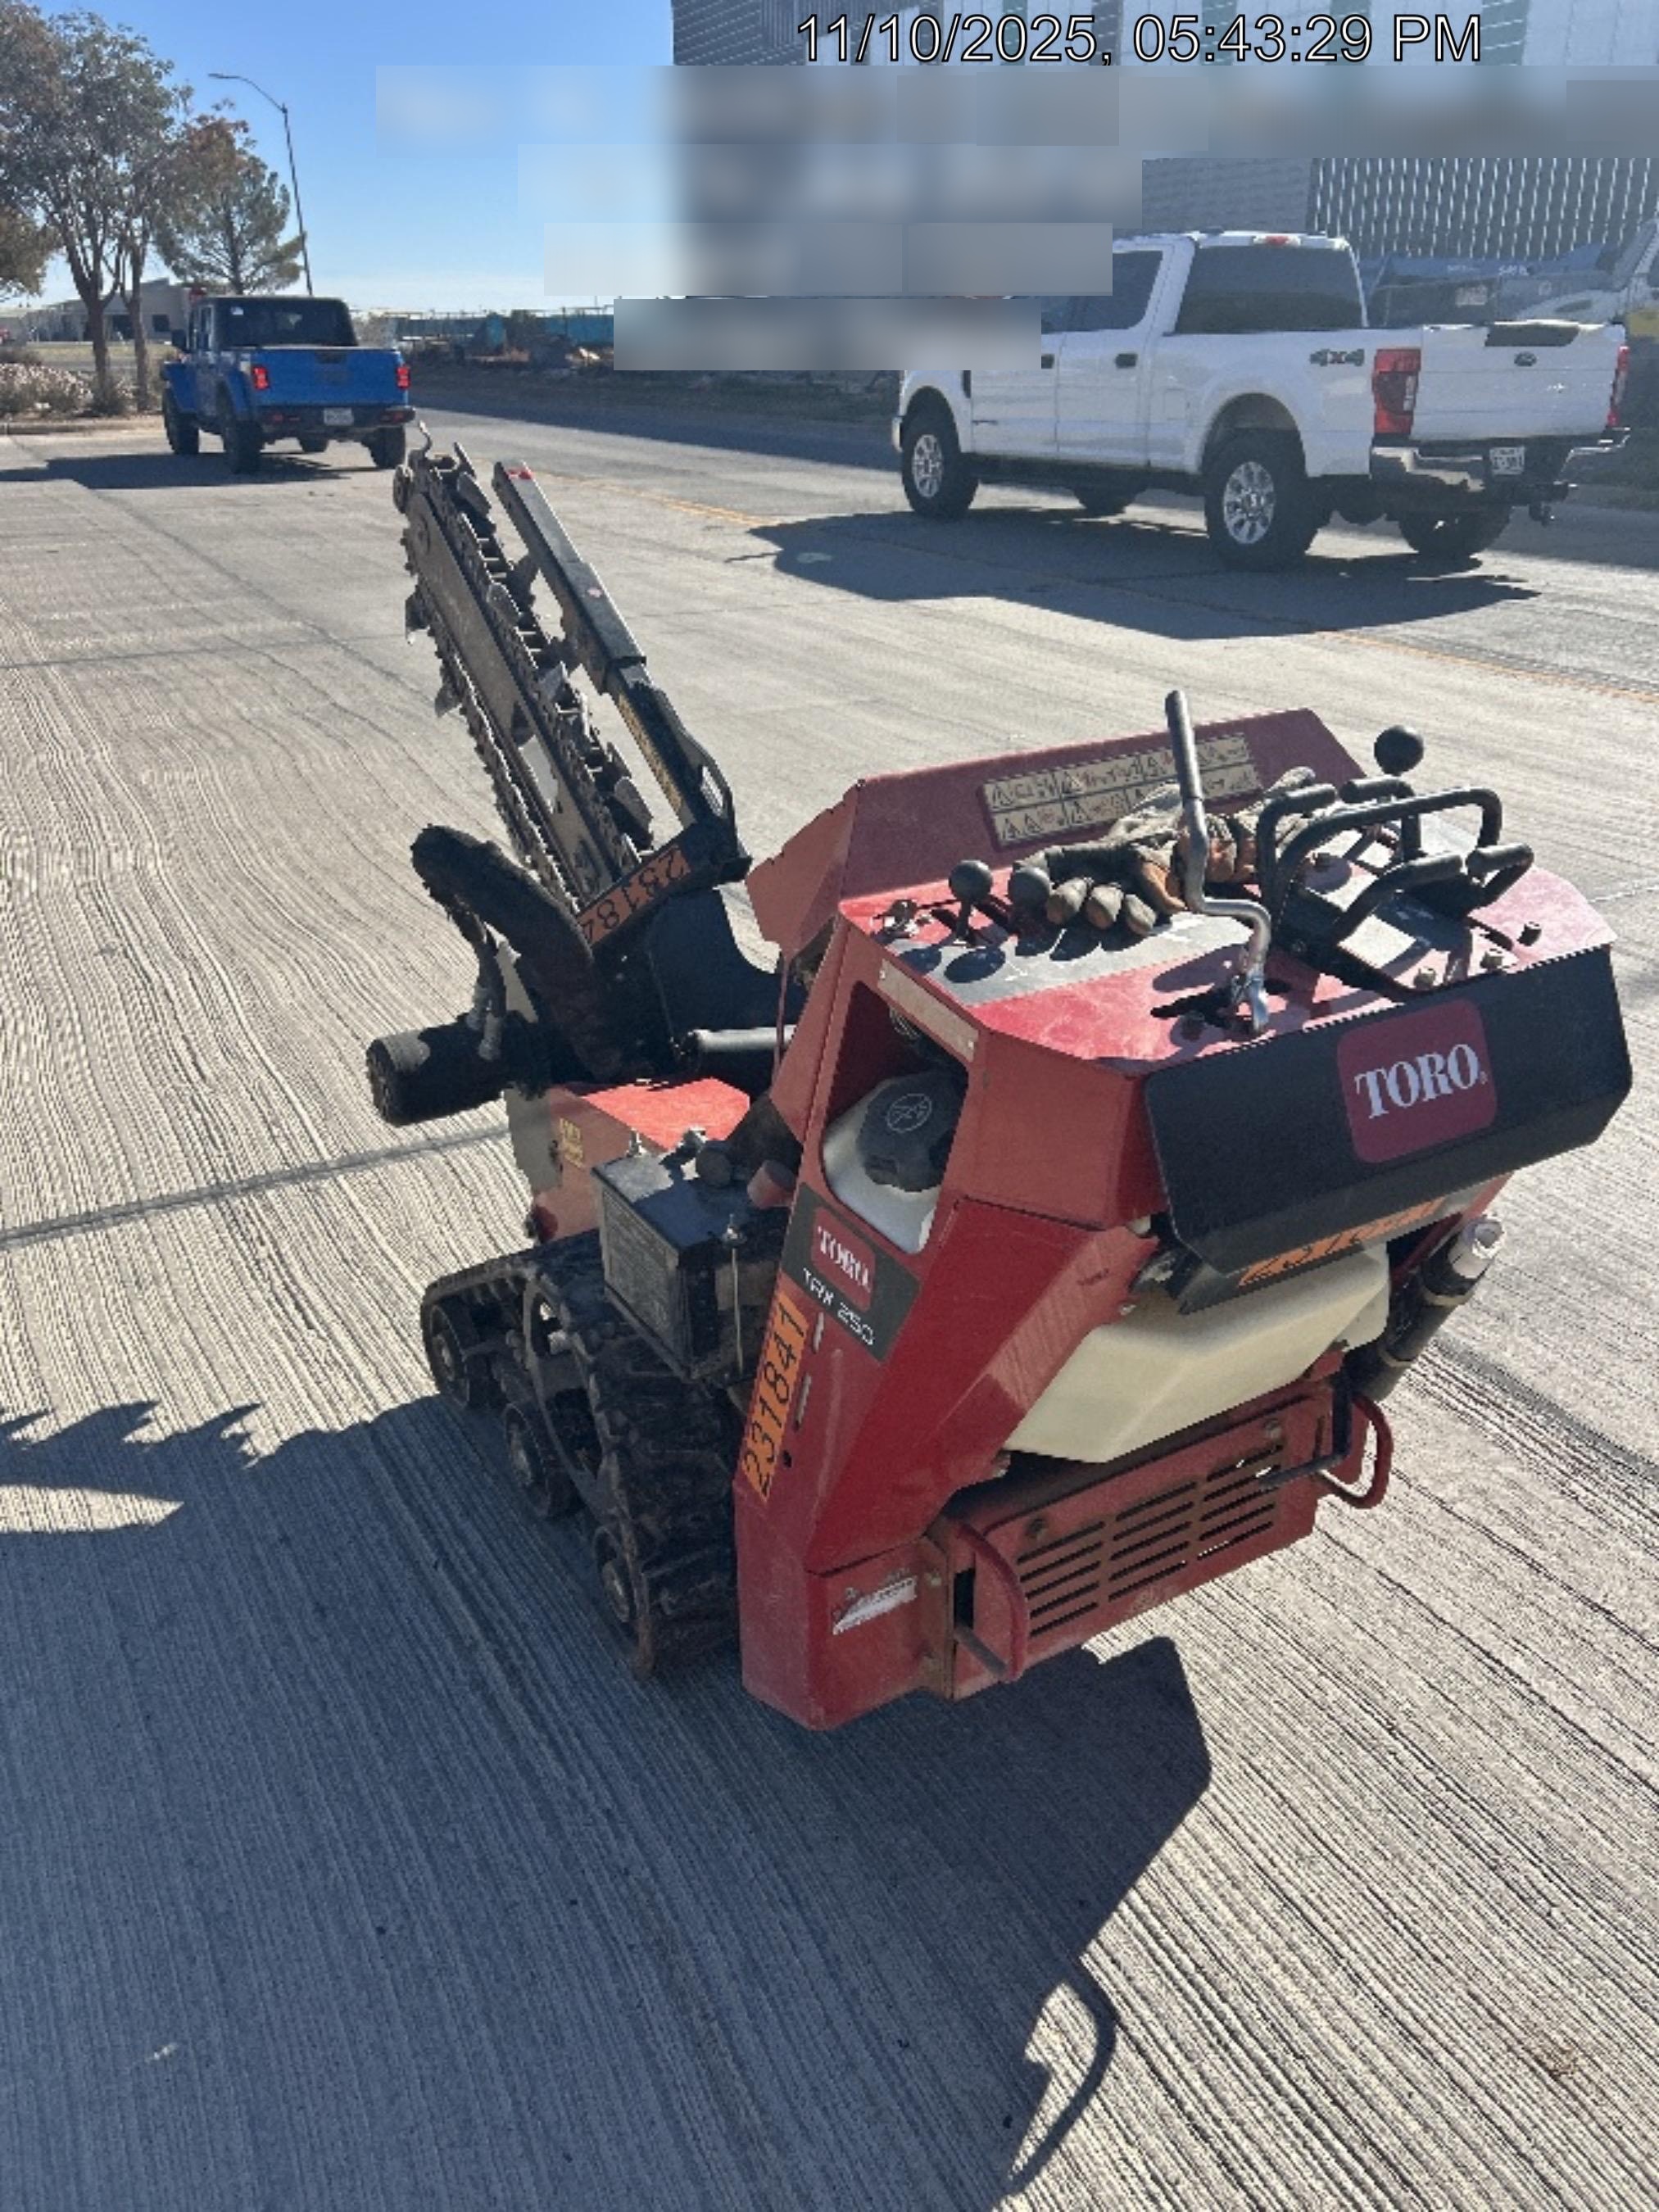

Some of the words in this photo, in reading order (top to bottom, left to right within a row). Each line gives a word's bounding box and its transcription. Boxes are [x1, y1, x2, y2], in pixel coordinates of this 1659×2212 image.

[1353, 1043, 1480, 1120] TORO
[802, 1267, 835, 1307] TRX
[836, 1302, 876, 1347] 250
[744, 1303, 806, 1498] 231841
